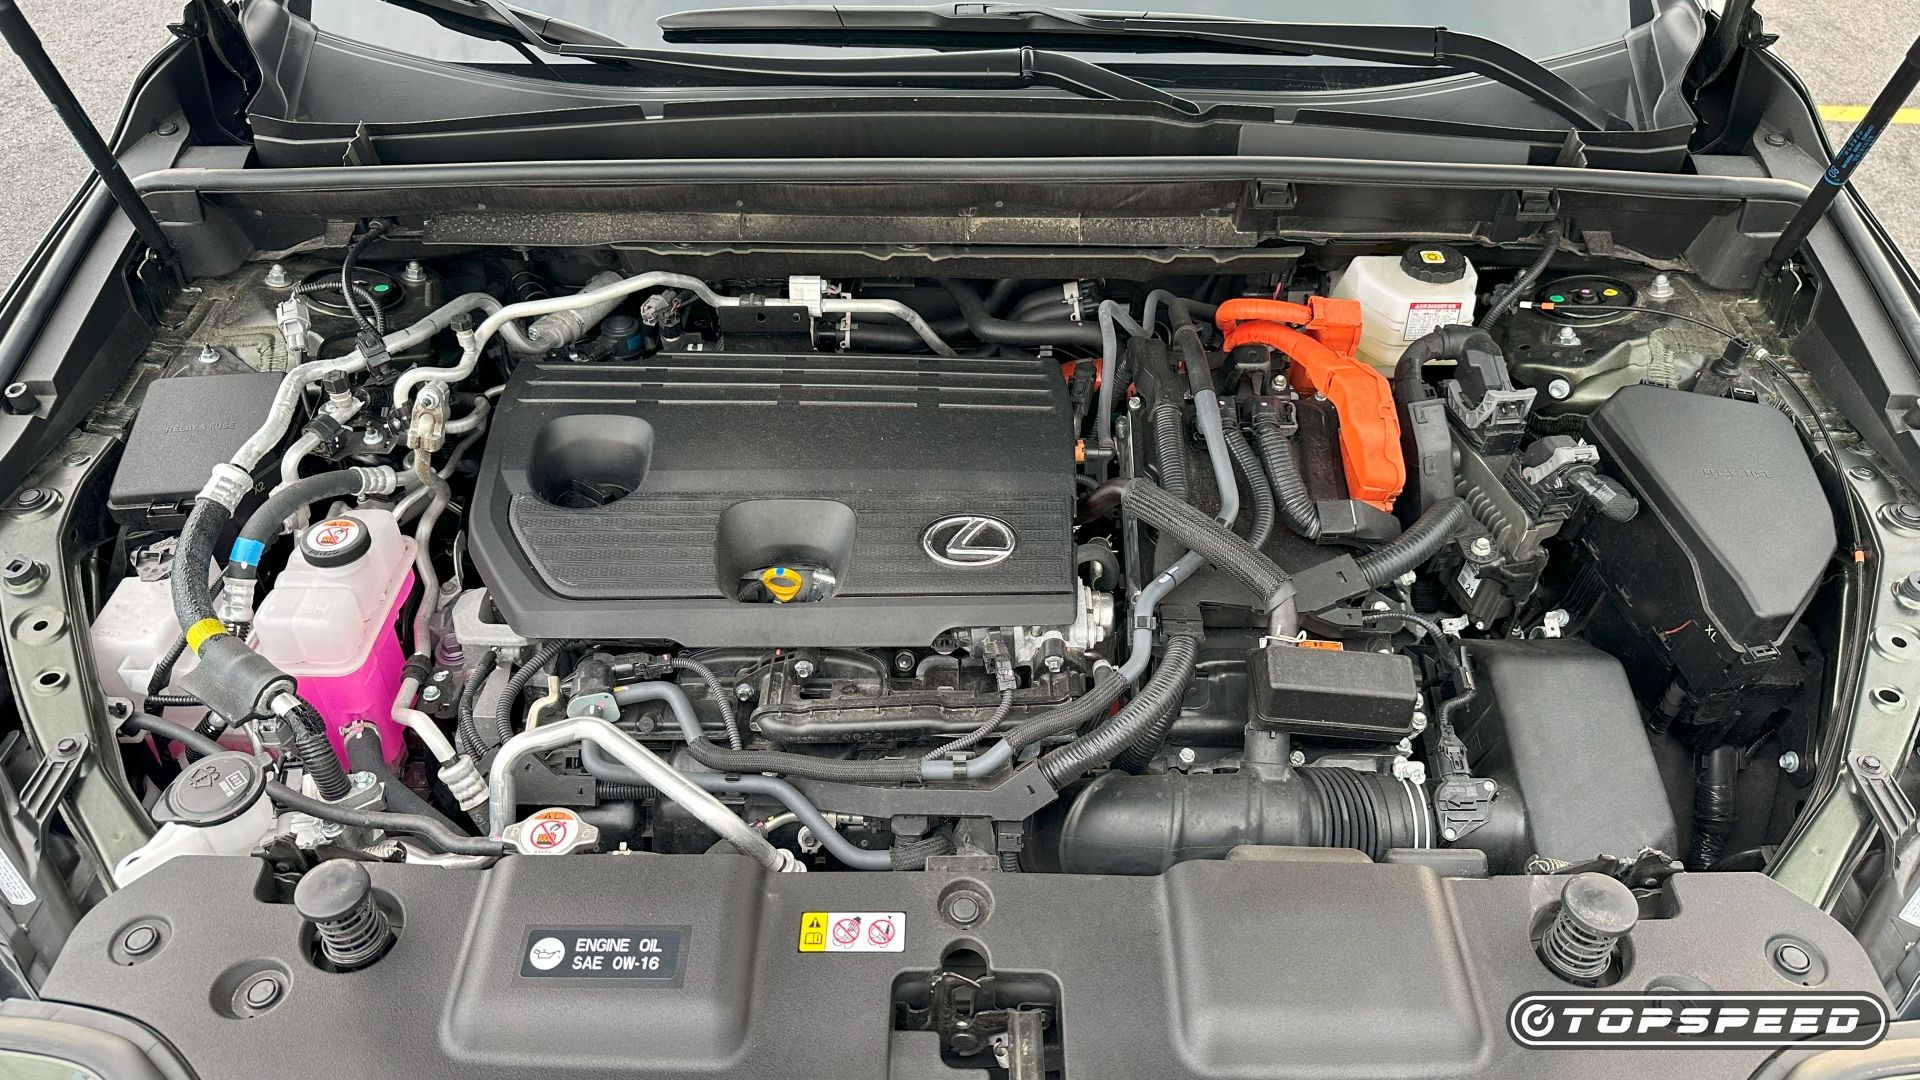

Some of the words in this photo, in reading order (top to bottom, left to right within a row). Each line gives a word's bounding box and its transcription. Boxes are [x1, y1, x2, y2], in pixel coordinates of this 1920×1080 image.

[165, 424, 198, 433] RELAY
[210, 421, 236, 431] FUSE
[1704, 624, 1717, 643] XL
[575, 938, 631, 952] ENGINE
[639, 938, 663, 953] OIL
[572, 956, 604, 970] SAE
[612, 956, 660, 970] 0W-16
